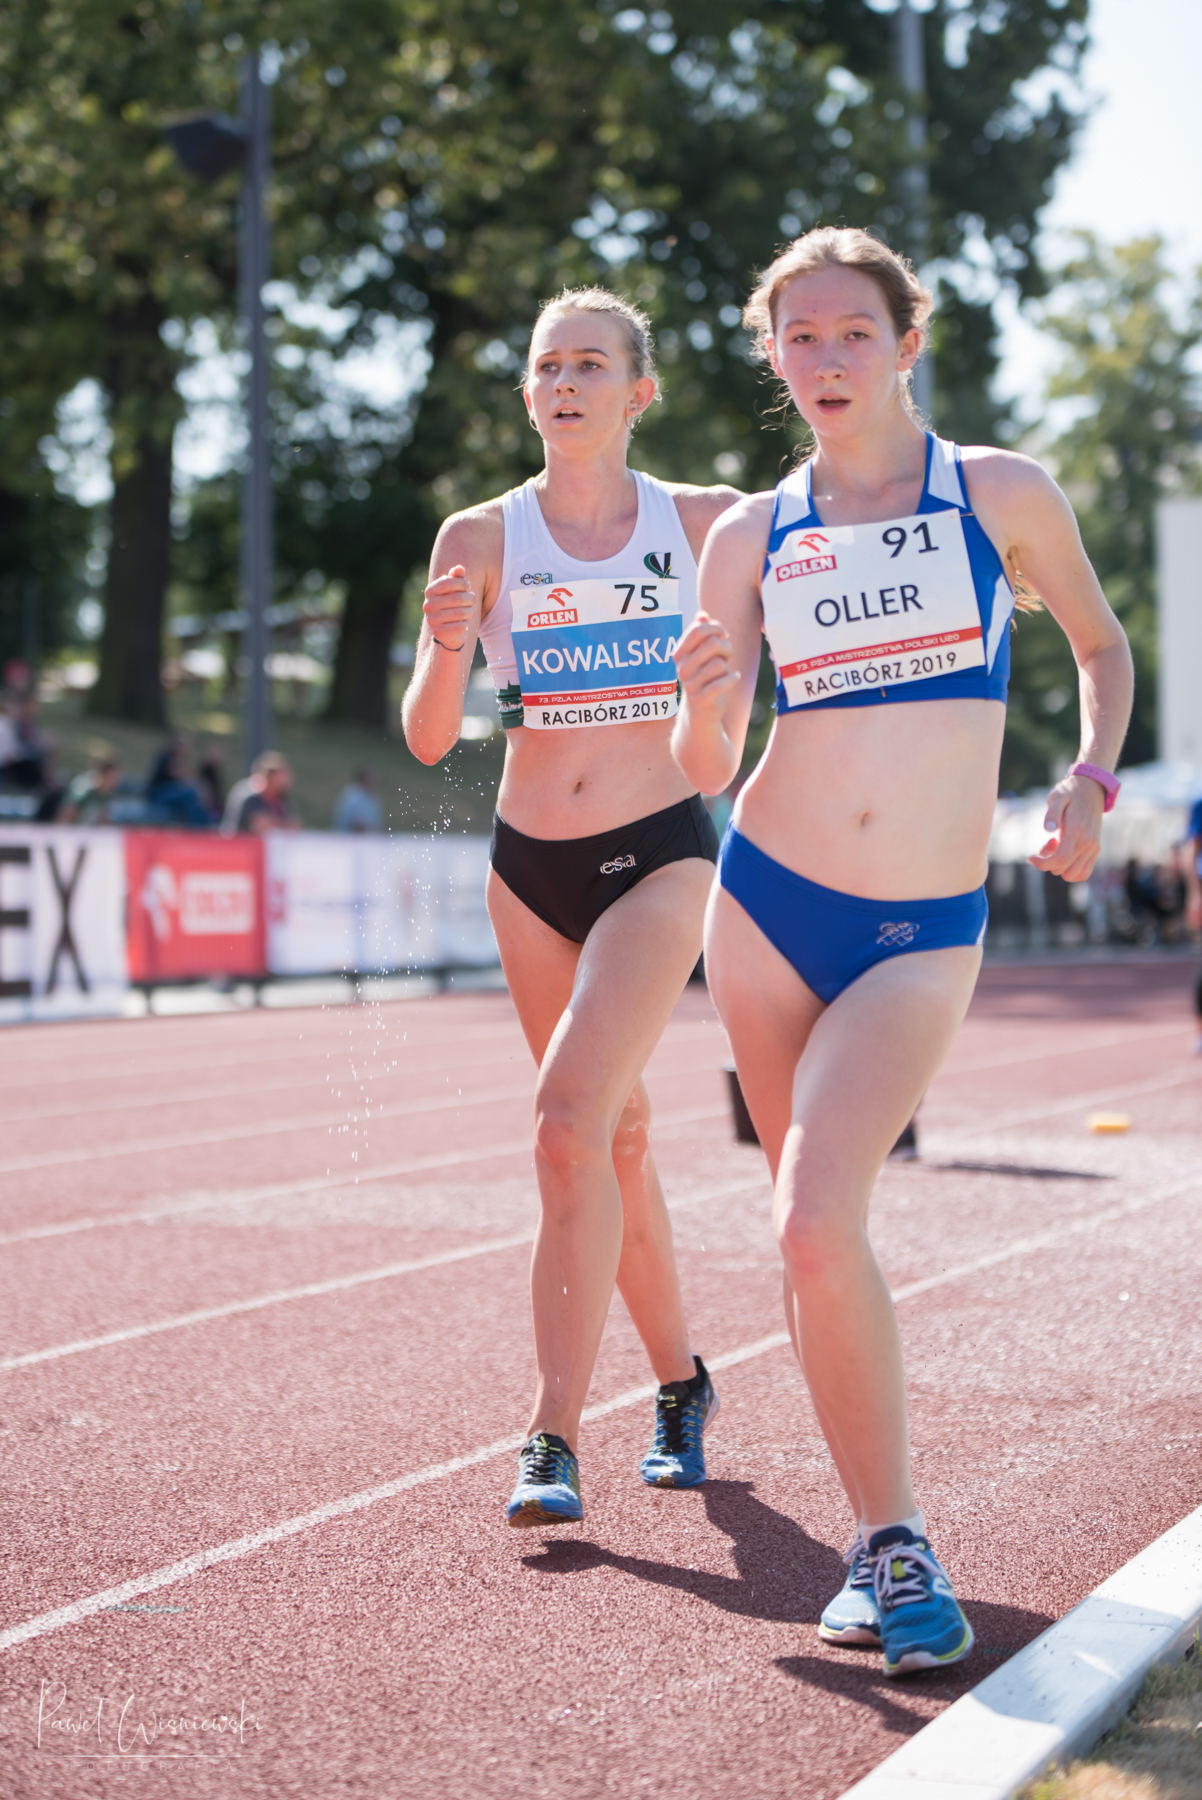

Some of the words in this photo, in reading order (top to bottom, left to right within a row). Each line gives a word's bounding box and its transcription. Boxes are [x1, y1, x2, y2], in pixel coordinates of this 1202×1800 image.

[882, 521, 940, 559] 91
[777, 556, 835, 580] ORLEN
[614, 583, 660, 615] 75
[814, 584, 925, 628] OLLER
[530, 610, 576, 626] ORLEN
[810, 656, 835, 668] PZLA
[835, 644, 903, 662] MISTRZOSTWA
[905, 638, 938, 650] POLSKI
[939, 633, 960, 644] U20
[804, 661, 905, 698] RACIBÓRZ
[910, 651, 957, 676] 2019
[573, 691, 628, 702] MISTRZOSTWA
[629, 688, 656, 696] POLSKI
[542, 703, 628, 726] RACIBÓRZ
[632, 700, 669, 718] 2019
